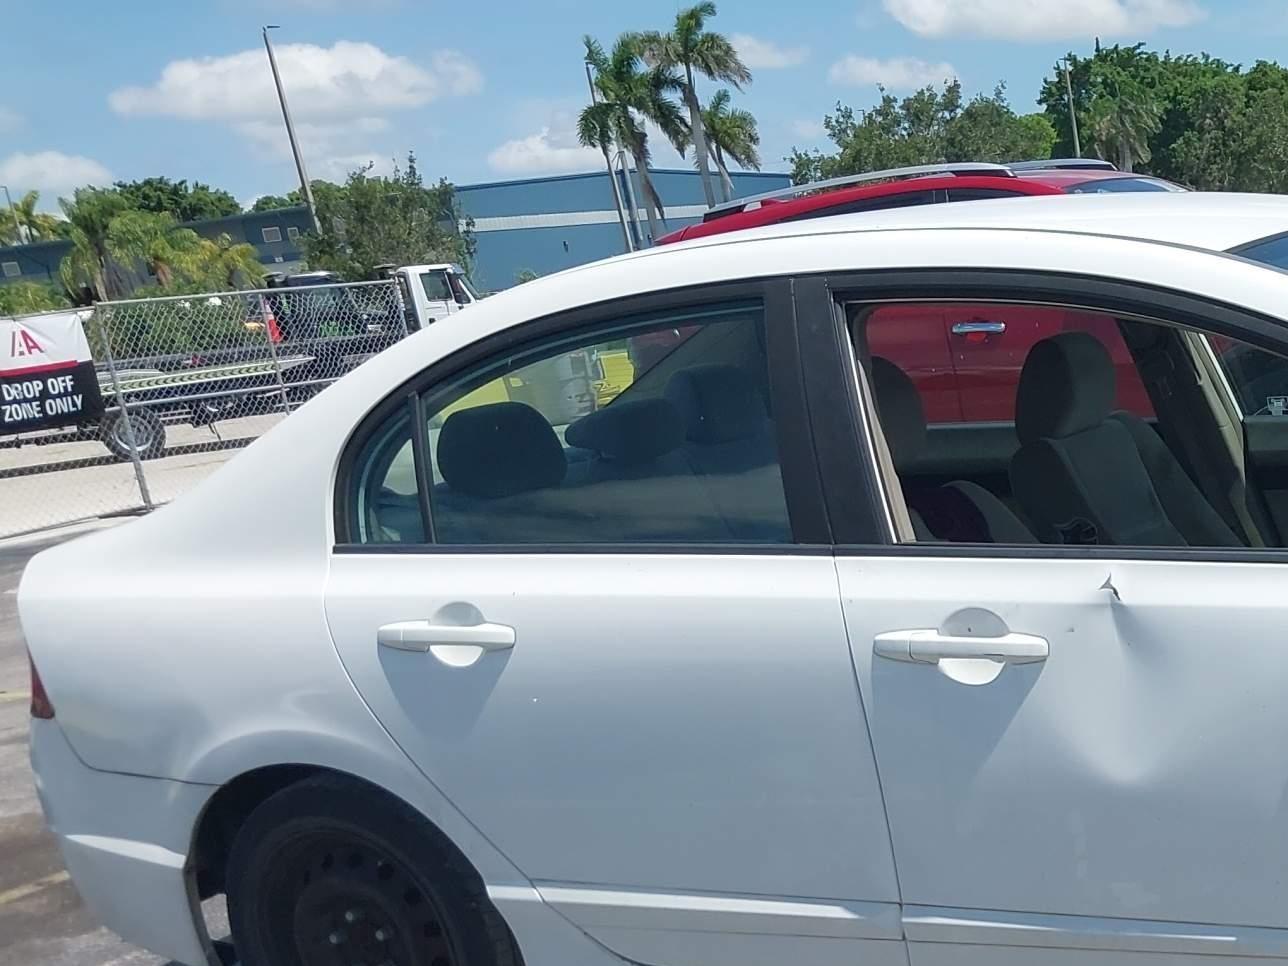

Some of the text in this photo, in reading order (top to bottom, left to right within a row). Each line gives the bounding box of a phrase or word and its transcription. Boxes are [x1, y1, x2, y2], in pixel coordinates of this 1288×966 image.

[1, 375, 74, 401] DROP OFF
[1, 394, 83, 423] ZONE ONLY
